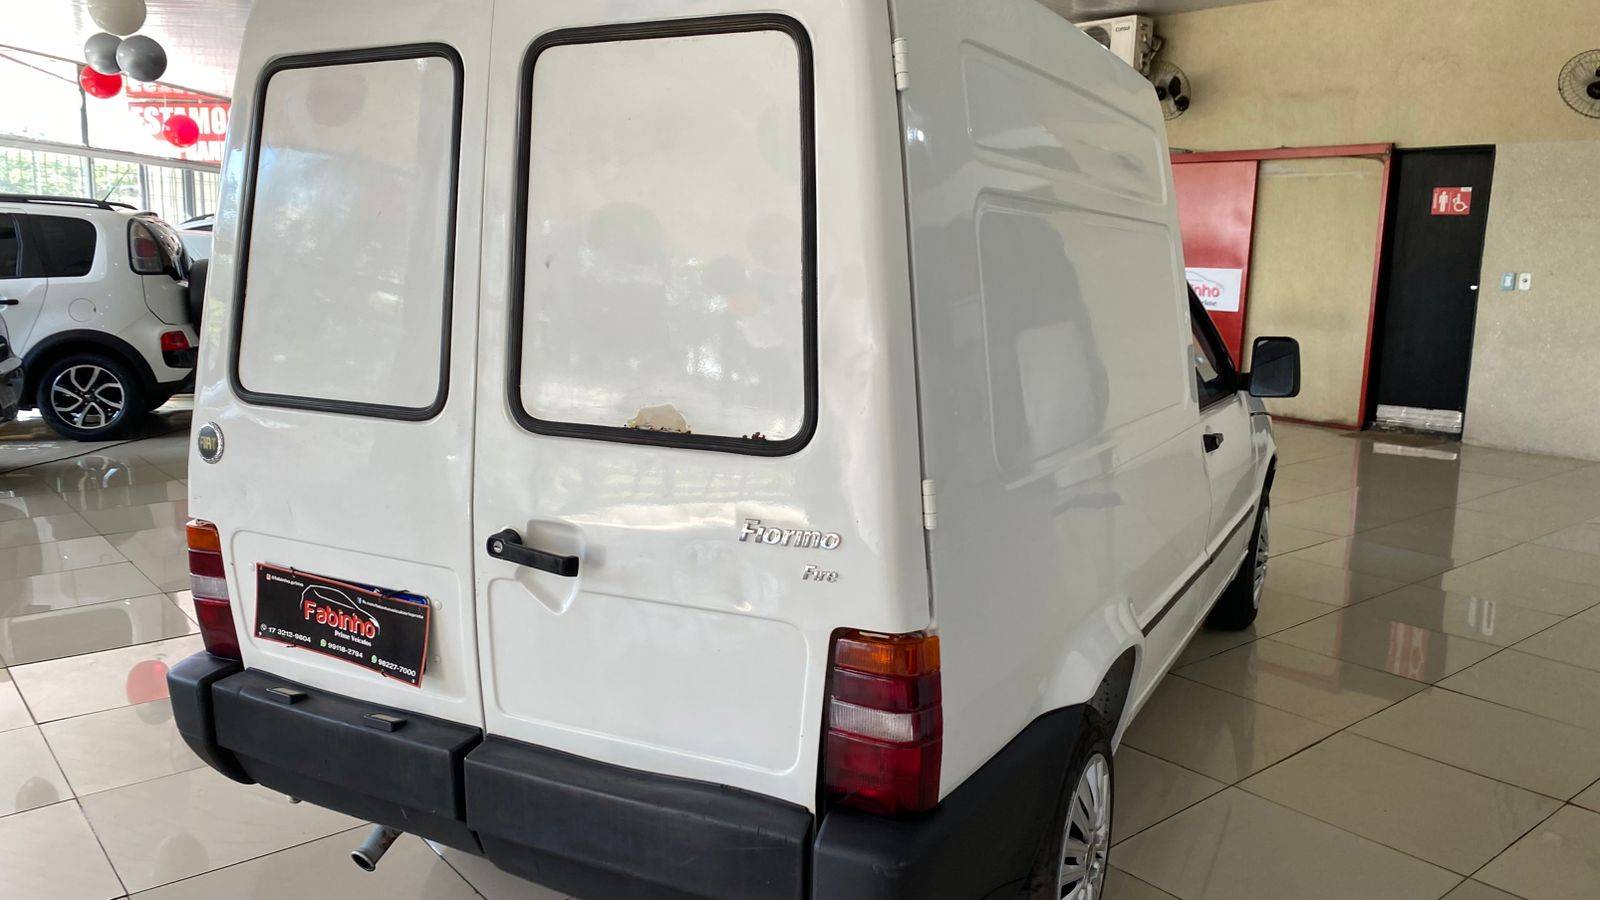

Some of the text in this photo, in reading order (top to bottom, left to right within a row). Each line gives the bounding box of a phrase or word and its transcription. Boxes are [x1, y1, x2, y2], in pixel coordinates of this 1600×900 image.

[130, 106, 230, 135] ESTMO
[739, 518, 842, 550] Fiorino
[802, 564, 839, 583] Fire
[303, 600, 376, 639] Fabinho
[334, 630, 350, 640] Prime
